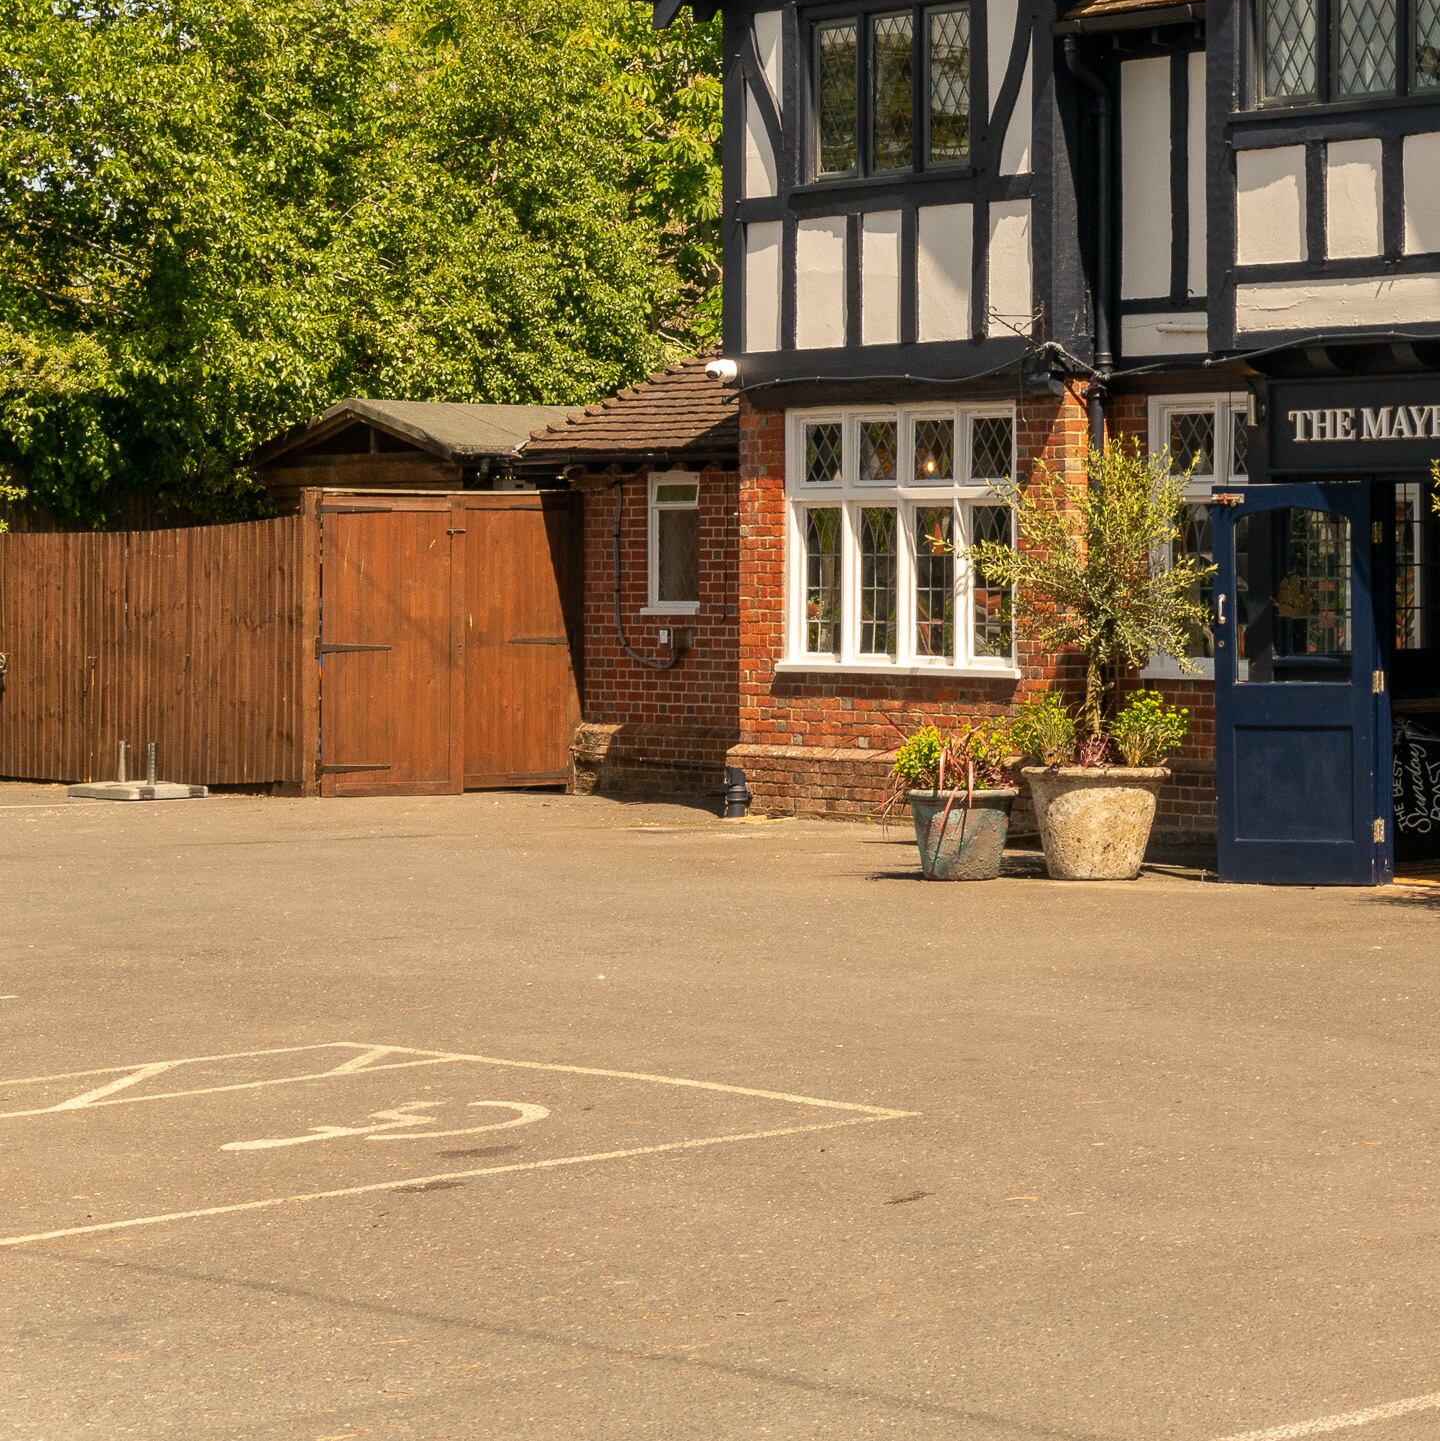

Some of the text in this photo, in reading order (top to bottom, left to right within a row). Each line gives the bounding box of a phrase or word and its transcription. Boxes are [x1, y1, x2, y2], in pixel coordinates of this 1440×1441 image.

[1288, 407, 1356, 442] THE
[1392, 754, 1405, 831] THE BEST
[1405, 743, 1432, 833] Sunday
